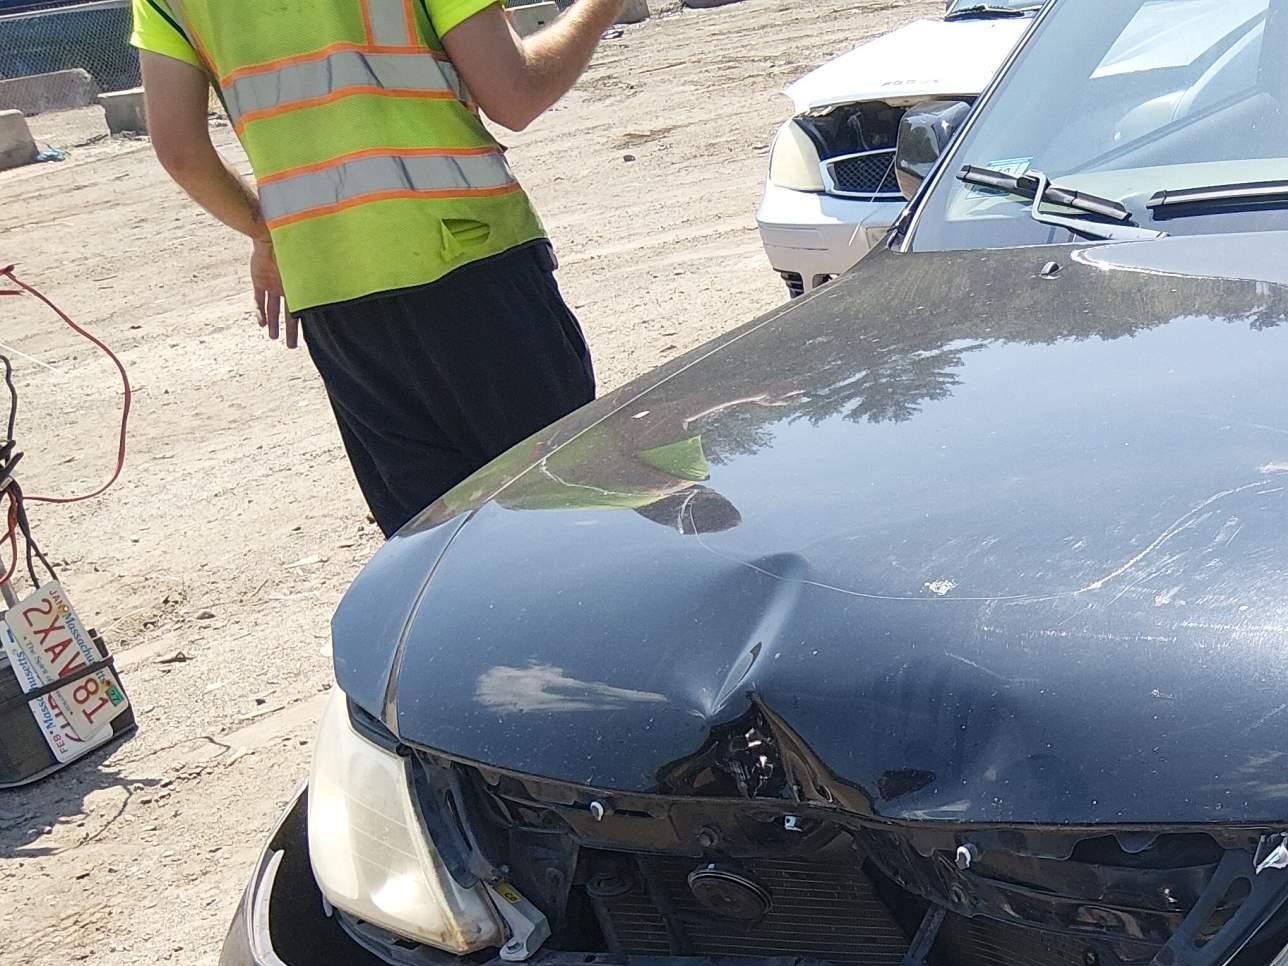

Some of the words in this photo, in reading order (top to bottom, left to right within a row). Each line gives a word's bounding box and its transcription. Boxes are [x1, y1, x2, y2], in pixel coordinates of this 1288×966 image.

[22, 598, 87, 678] 2XAV
[73, 677, 109, 724] 81
[53, 733, 68, 754] FEB
